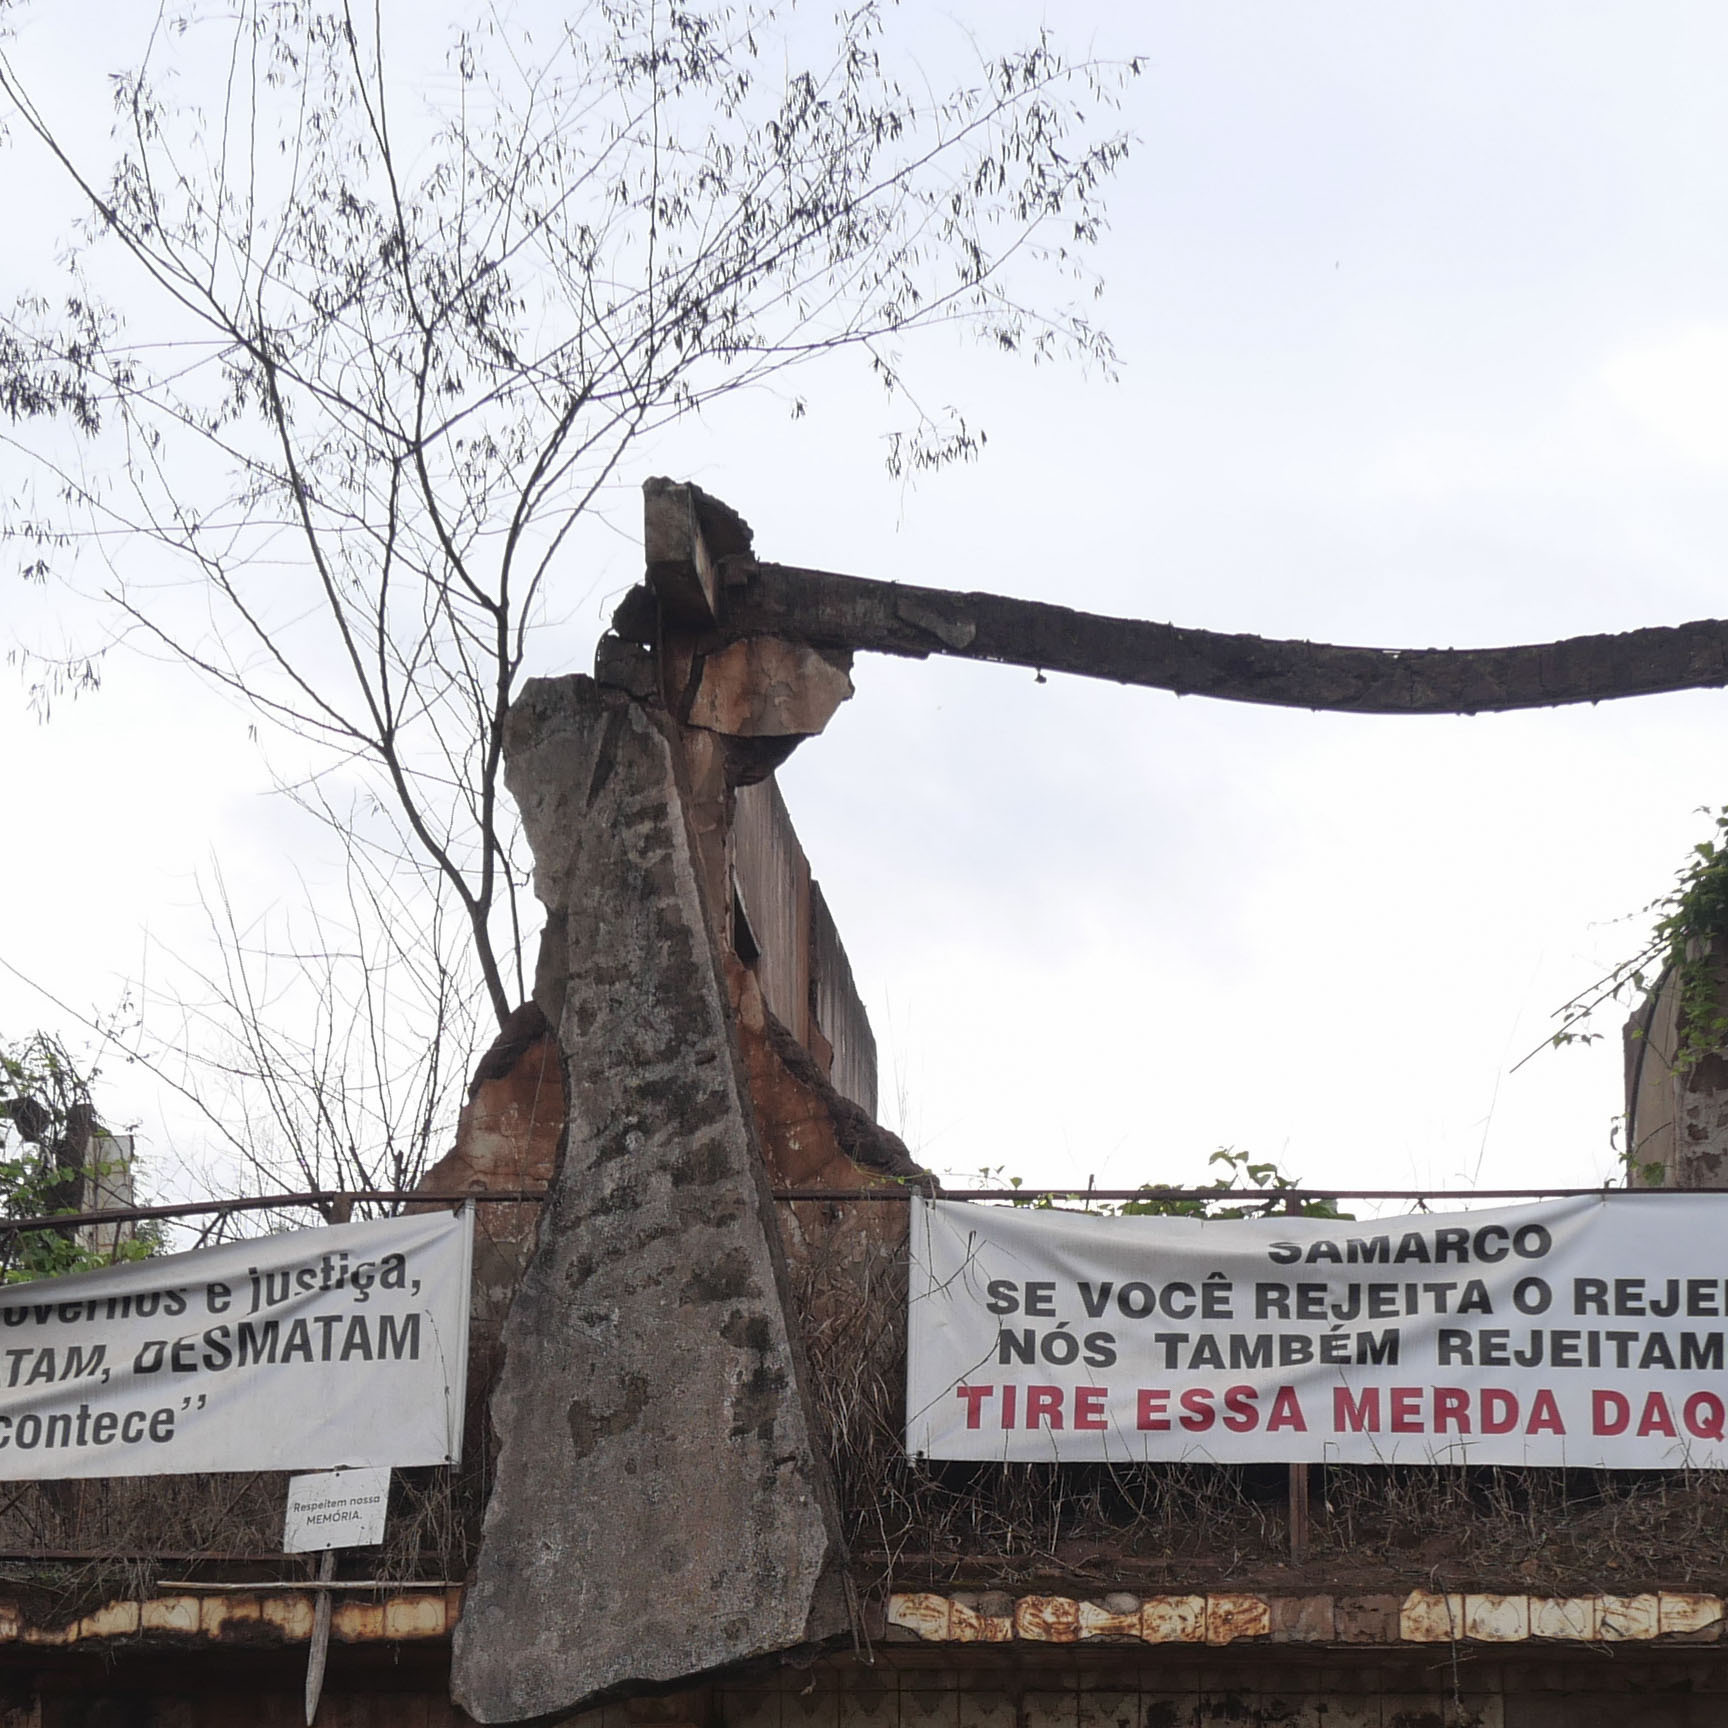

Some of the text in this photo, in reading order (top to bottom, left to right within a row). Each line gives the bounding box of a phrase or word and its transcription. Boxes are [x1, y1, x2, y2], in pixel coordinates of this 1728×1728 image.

[1268, 1223, 1552, 1265] SAMARCO
[206, 1281, 233, 1314] e
[247, 1252, 422, 1316] justiça,
[985, 1278, 1057, 1317] SE
[1077, 1271, 1234, 1320] VOCÊ
[1255, 1278, 1494, 1321] REJEITA
[1512, 1276, 1553, 1316] O
[132, 1312, 421, 1375] DESMATAM
[997, 1321, 1118, 1369] NÓS
[1154, 1324, 1400, 1370] TAMBÉM
[956, 1384, 1109, 1431] TIRE
[1137, 1385, 1308, 1433] ESSA
[1333, 1386, 1567, 1436] MERDA
[293, 1495, 381, 1513] Respeitem nossa
[306, 1510, 363, 1526] MEMÓRIA.
